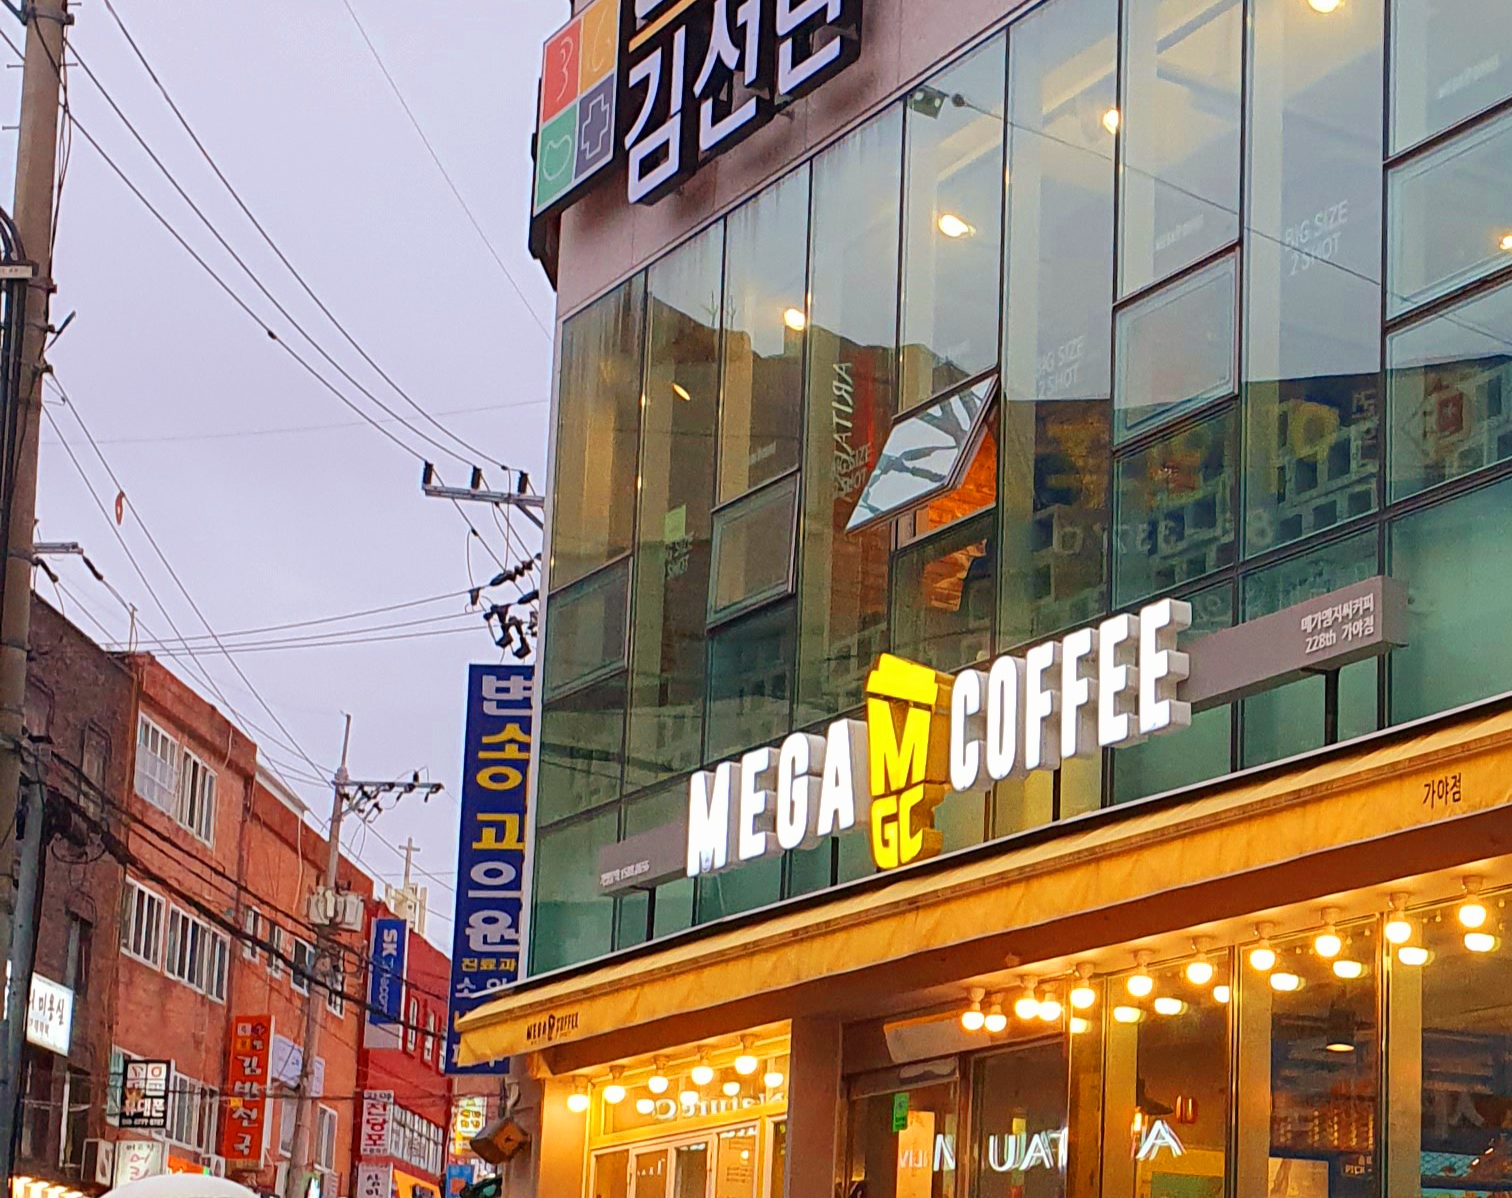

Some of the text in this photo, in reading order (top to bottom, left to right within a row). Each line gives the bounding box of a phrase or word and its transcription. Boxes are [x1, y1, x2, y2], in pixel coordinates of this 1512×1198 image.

[1301, 592, 1374, 634] 메가엠지씨커피
[1305, 614, 1375, 654] 228th 가야점
[687, 718, 858, 878] MEGA
[950, 599, 1180, 792] COFFEE
[1422, 772, 1462, 807] 가야점
[382, 928, 398, 957] SK
